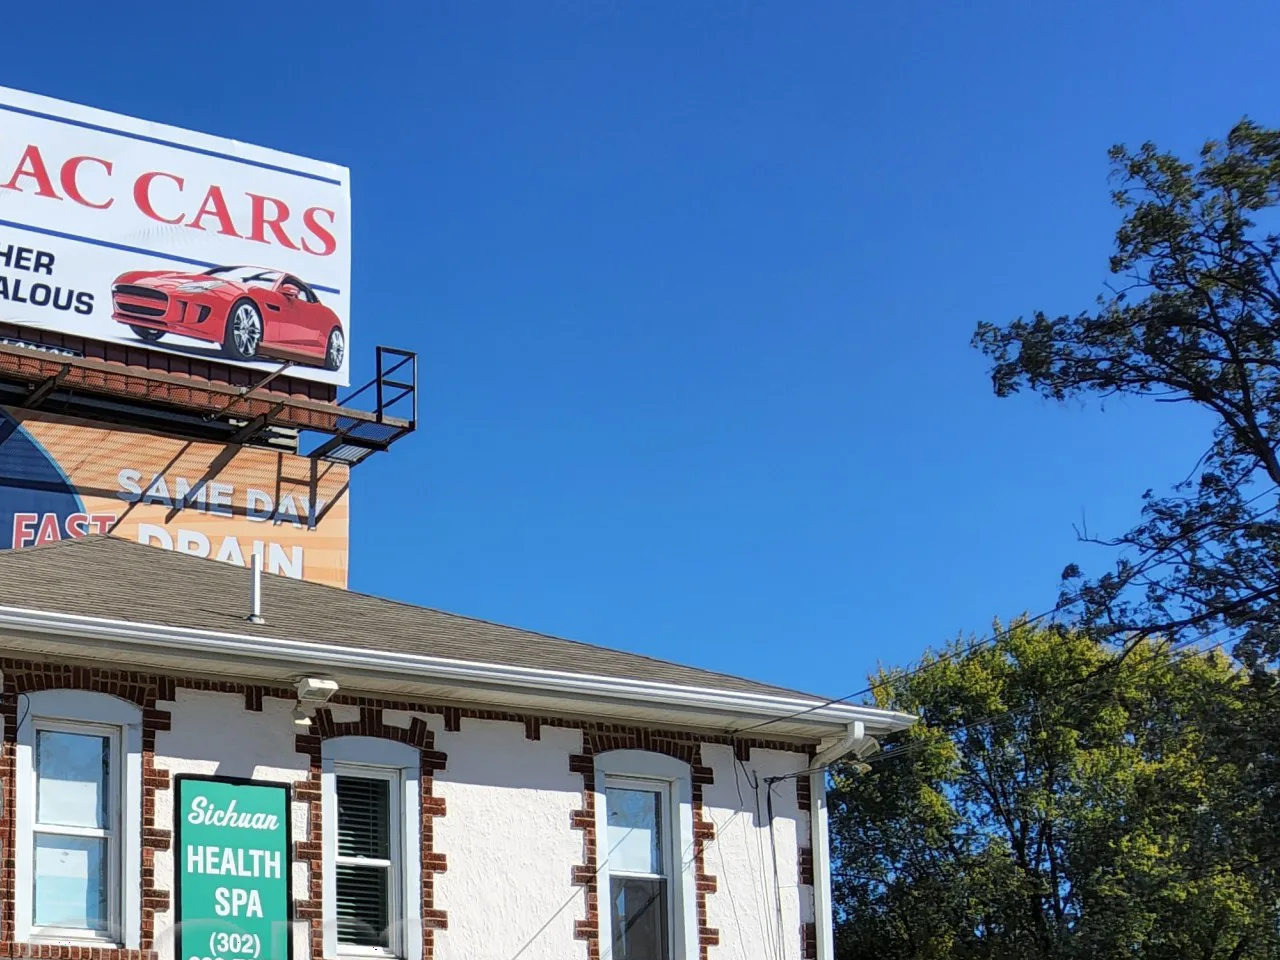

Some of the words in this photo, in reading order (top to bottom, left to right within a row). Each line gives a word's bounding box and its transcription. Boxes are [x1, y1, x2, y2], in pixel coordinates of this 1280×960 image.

[133, 171, 337, 257] CARS
[116, 468, 234, 519] SAME
[246, 488, 327, 532] DAY
[188, 795, 280, 831] Sichuan
[187, 845, 282, 879] HEALTH
[214, 887, 264, 918] SPA
[209, 931, 261, 959] (302)
